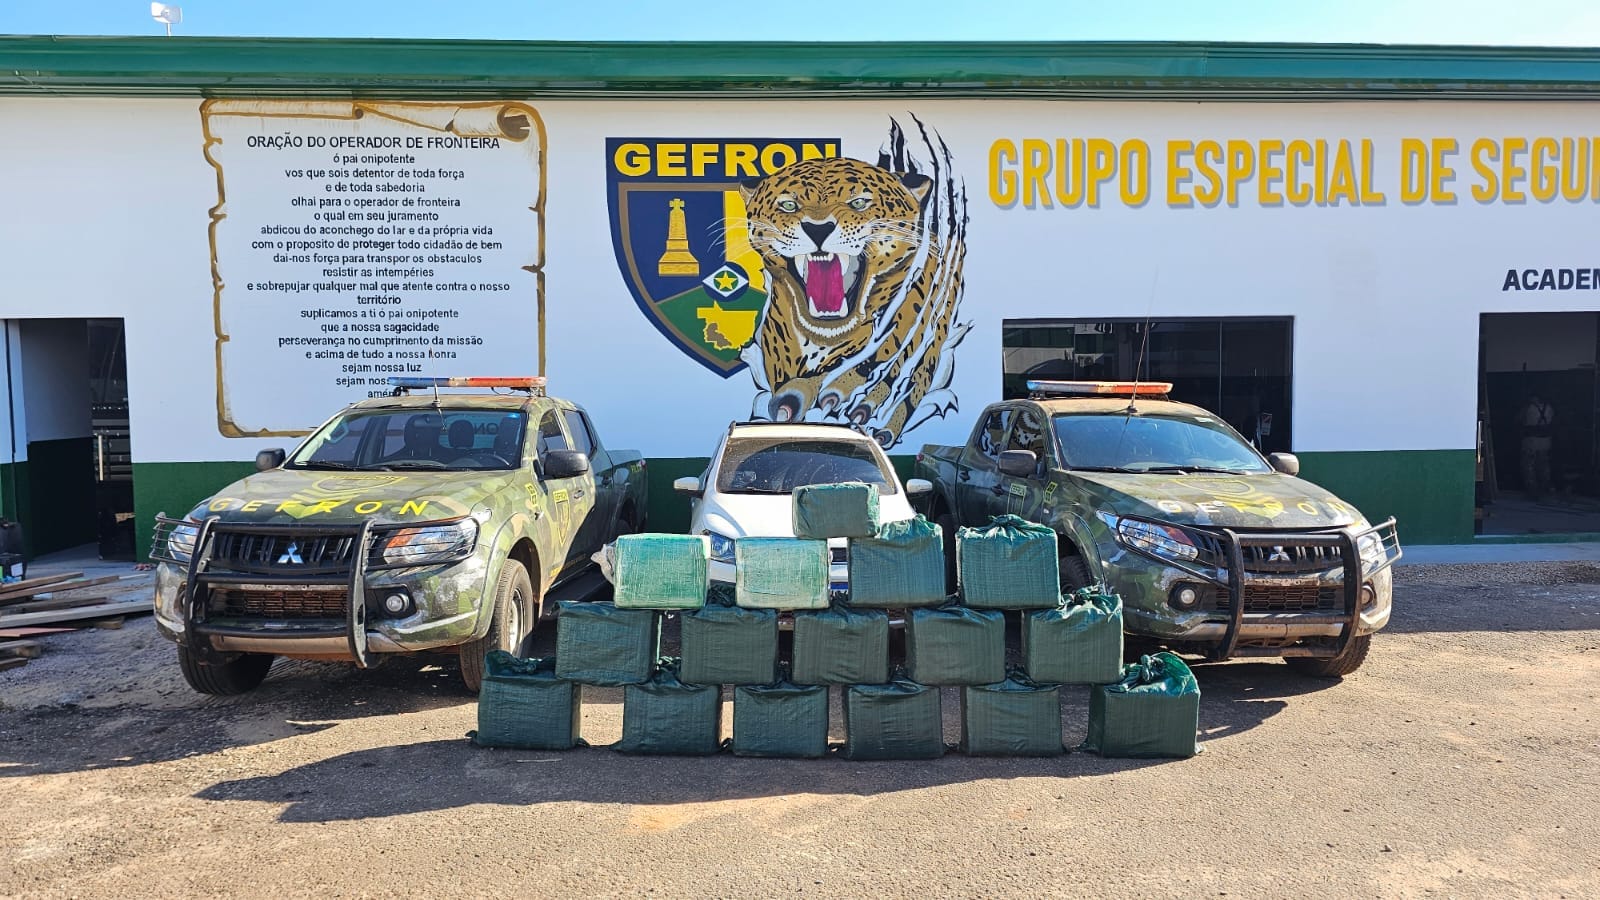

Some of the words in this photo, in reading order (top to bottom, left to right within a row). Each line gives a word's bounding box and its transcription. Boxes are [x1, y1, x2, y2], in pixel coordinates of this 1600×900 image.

[247, 132, 303, 150] ORAÇÃO
[307, 136, 326, 149] DO
[329, 136, 402, 149] OPERADOR
[406, 136, 423, 149] DE
[427, 137, 500, 149] FRONTEIRA
[343, 153, 357, 165] pai
[361, 153, 415, 166] onipotente
[285, 169, 303, 178] vos
[306, 169, 325, 180] que
[329, 167, 349, 177] sois
[353, 167, 395, 177] detentor
[398, 167, 410, 178] de
[413, 168, 435, 178] toda
[439, 168, 464, 180] força
[988, 138, 1151, 209] GRUPO
[1166, 138, 1386, 206] ESPECIAL
[1400, 137, 1458, 205] DE
[335, 180, 347, 192] de
[350, 181, 372, 192] toda
[376, 182, 424, 192] sabedoria
[292, 195, 316, 206] olhai
[320, 198, 341, 209] para
[354, 196, 399, 208] operador
[402, 196, 414, 206] de
[417, 196, 460, 206] fronteira
[323, 210, 345, 222] qual
[348, 212, 363, 221] em
[367, 212, 384, 221] seu
[387, 210, 438, 223] juramento
[261, 224, 300, 234] abdicou
[304, 224, 316, 234] do
[320, 224, 374, 238] aconchego
[377, 224, 390, 234] do
[393, 224, 405, 234] lar
[418, 225, 430, 235] da
[433, 224, 468, 237] própria
[472, 225, 492, 235] vida
[252, 240, 273, 250] com
[287, 238, 334, 251] proposito
[337, 238, 349, 248] de
[353, 239, 395, 251] proteger
[397, 239, 420, 249] todo
[424, 239, 463, 249] cidadão
[466, 239, 477, 249] de
[481, 239, 502, 249] bem
[273, 252, 310, 262] dai-nos
[314, 252, 339, 265] força
[342, 255, 364, 265] para
[367, 253, 410, 265] transpor
[413, 255, 424, 264] os
[428, 253, 481, 263] obstaculos
[323, 266, 358, 277] resistir
[361, 268, 372, 278] as
[376, 266, 434, 278] intempéries
[257, 280, 310, 293] sobrepujar
[313, 280, 356, 293] qualquer
[360, 280, 378, 291] mal
[381, 282, 399, 293] que
[403, 281, 433, 291] atente
[436, 281, 467, 291] contra
[480, 283, 509, 292] nosso
[357, 294, 401, 304] território
[301, 308, 358, 320] suplicamos
[368, 308, 377, 318] ti
[389, 308, 403, 320] pai
[406, 308, 458, 320] onipotente
[321, 323, 339, 334] que
[351, 323, 381, 333] nossa
[384, 321, 439, 334] sagacidade
[279, 336, 345, 347] perseverança
[348, 337, 360, 346] no
[363, 335, 429, 347] cumprimento
[432, 335, 443, 345] da
[447, 335, 483, 345] missão
[315, 349, 344, 359] acima
[347, 349, 359, 359] de
[362, 348, 384, 358] tudo
[396, 351, 425, 359] nossa
[343, 362, 371, 374] sejam
[375, 364, 404, 373] nossa
[407, 362, 422, 372] luz
[336, 376, 365, 387] sejam
[208, 498, 430, 516] GEFRON
